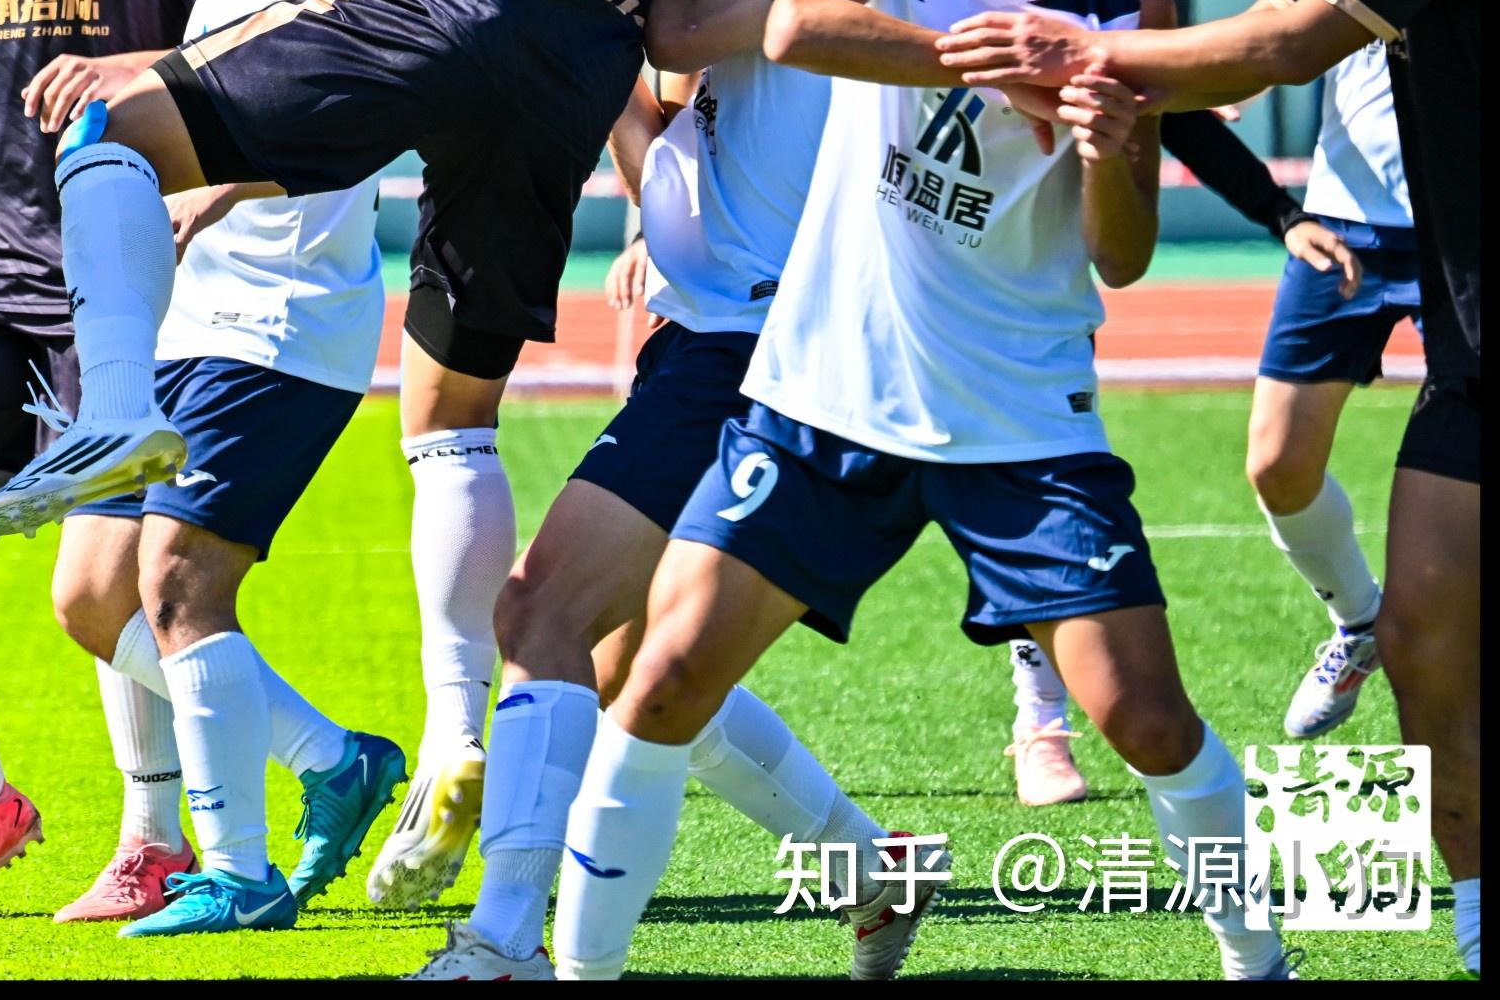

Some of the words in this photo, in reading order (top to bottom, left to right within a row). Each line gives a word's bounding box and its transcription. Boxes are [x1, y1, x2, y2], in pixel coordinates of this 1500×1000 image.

[32, 25, 73, 38] ZHAO
[906, 206, 944, 236] WEN
[957, 231, 983, 249] JU
[716, 451, 779, 522] 9
